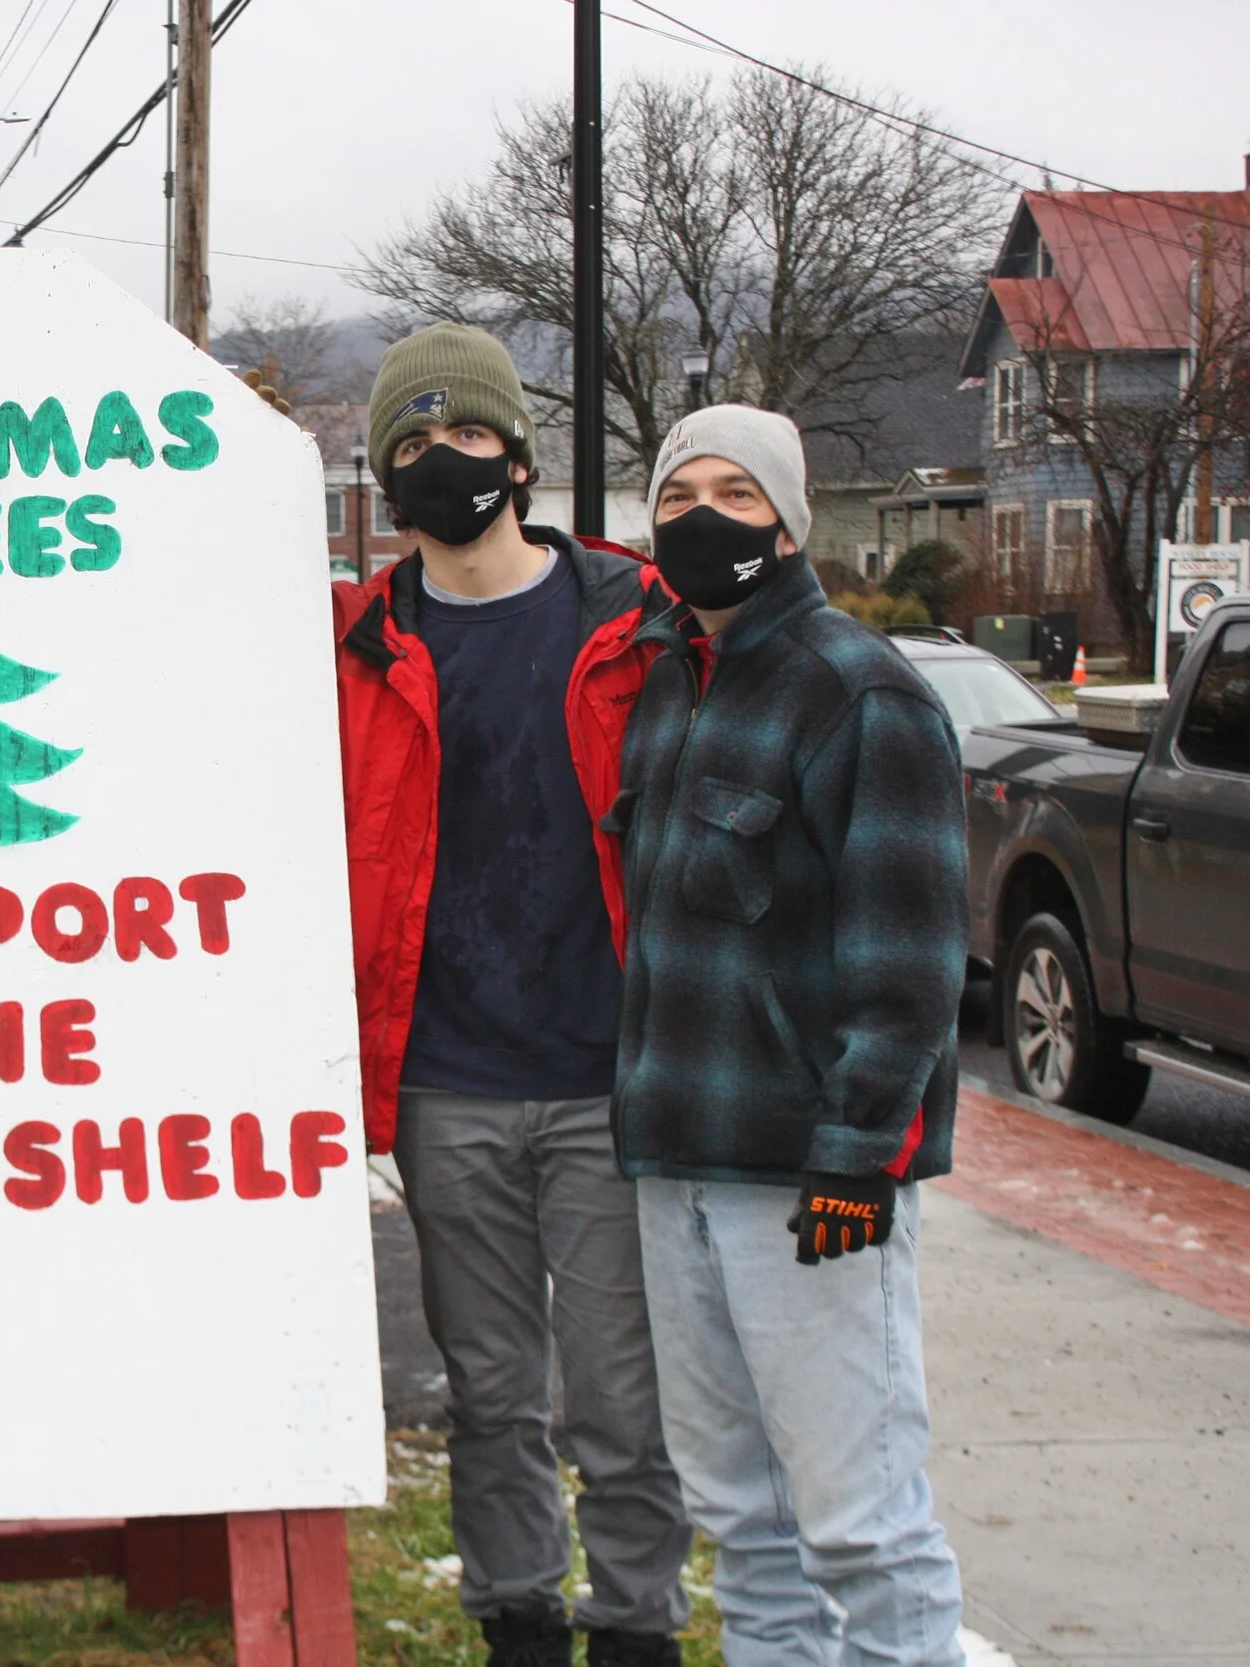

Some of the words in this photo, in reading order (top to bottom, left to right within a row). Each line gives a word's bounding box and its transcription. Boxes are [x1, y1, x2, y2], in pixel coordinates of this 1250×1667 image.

[473, 490, 500, 503] Reebok
[733, 557, 763, 572] Reebok
[3, 1110, 349, 1211] SHELF
[810, 1196, 876, 1220] STIHL
